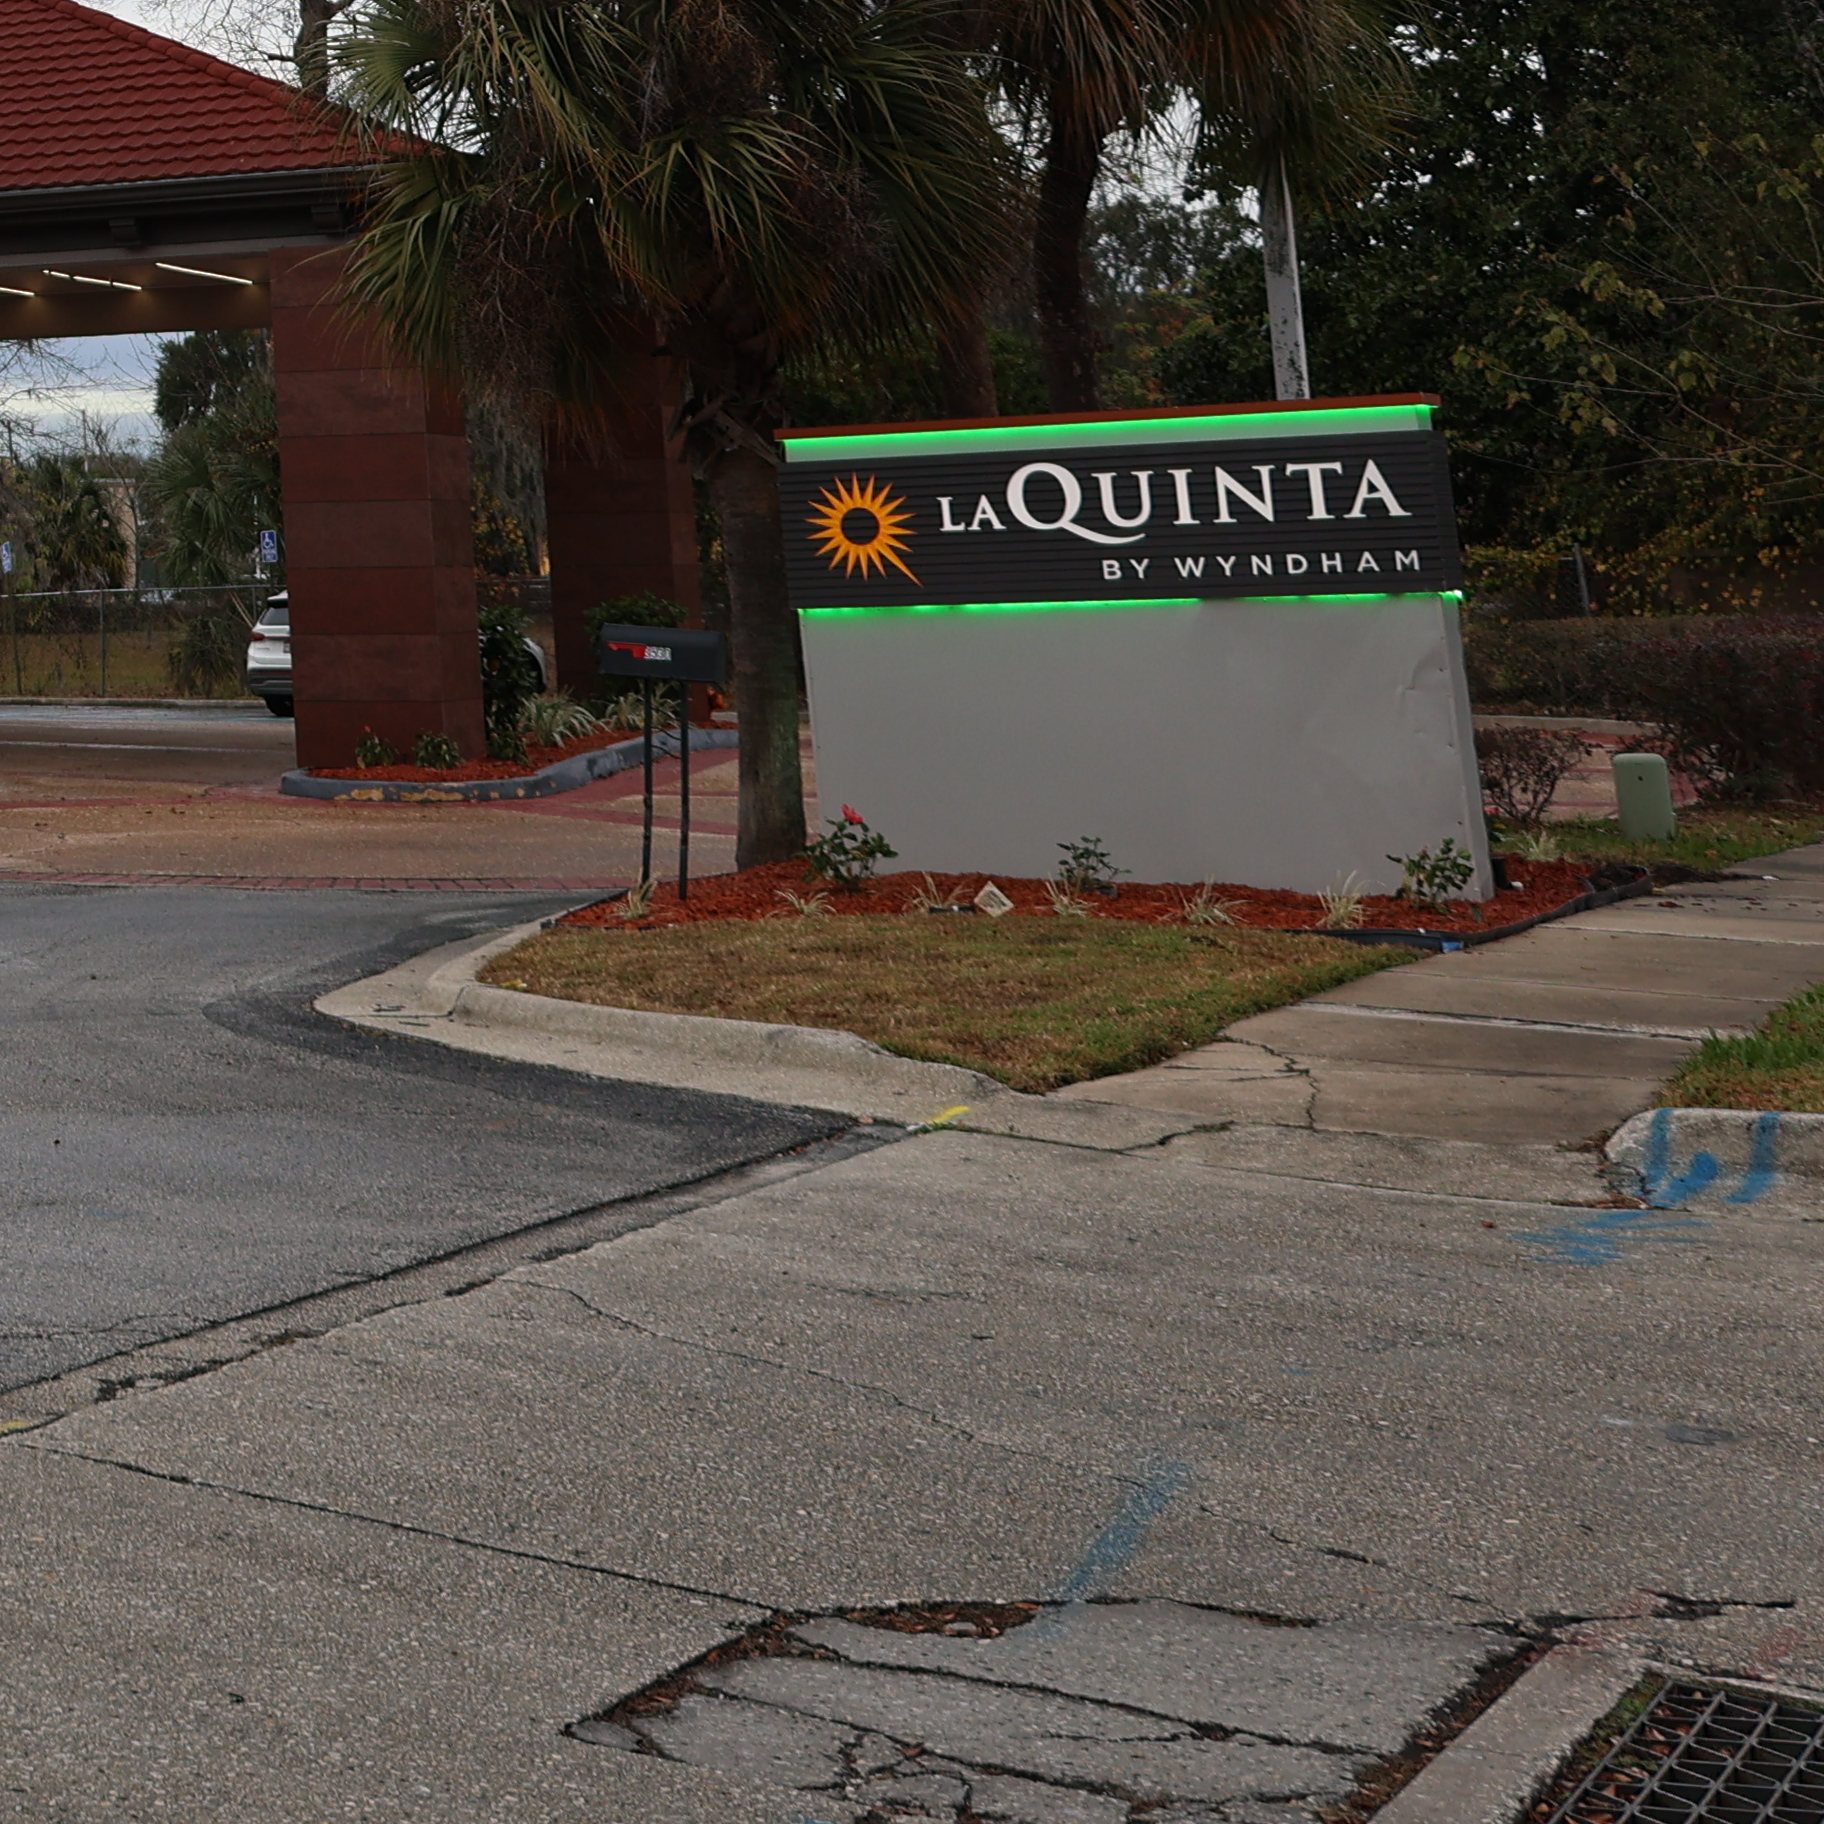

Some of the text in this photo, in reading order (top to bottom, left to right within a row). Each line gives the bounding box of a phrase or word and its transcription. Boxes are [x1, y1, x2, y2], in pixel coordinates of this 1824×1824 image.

[936, 458, 1414, 545] LA QUINTA
[1101, 549, 1421, 581] BY WYNDHAM
